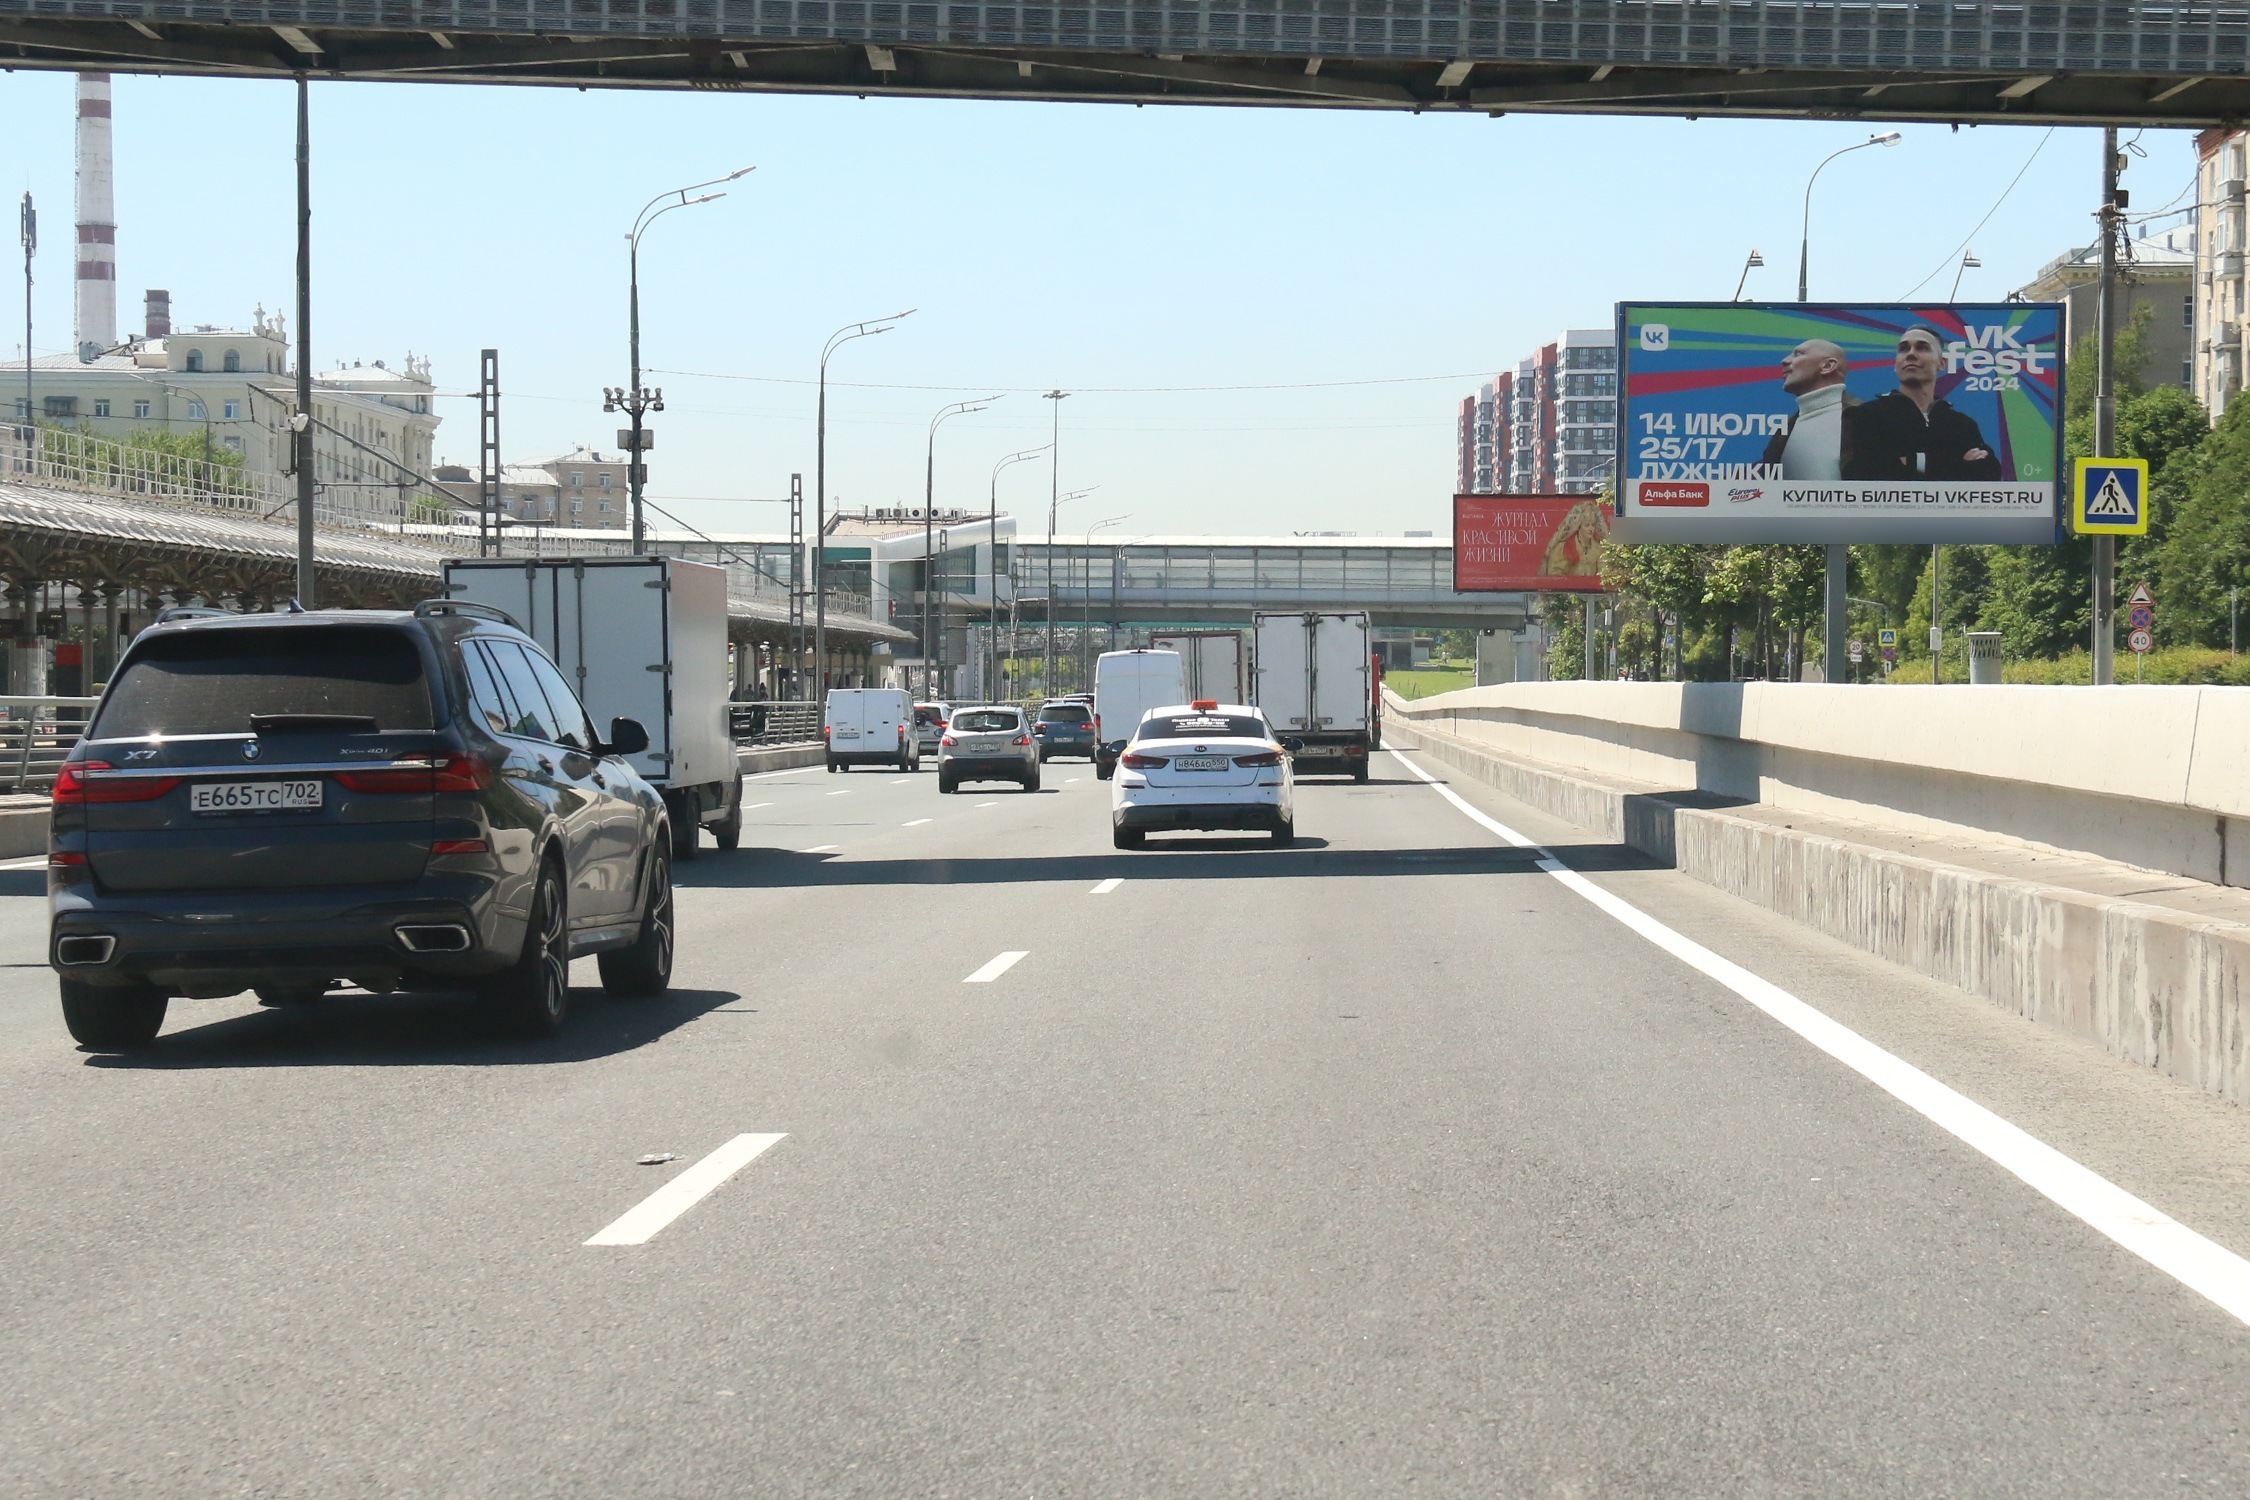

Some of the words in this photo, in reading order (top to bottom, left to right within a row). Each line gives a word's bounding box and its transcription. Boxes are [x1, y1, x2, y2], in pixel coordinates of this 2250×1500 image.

[1964, 325, 2023, 349] VK
[1942, 341, 2056, 375] fest
[1965, 376, 2020, 391] 2024
[1639, 412, 1676, 435] 14
[1685, 413, 1788, 436] ИЮЛЯ
[1639, 437, 1726, 460] 25/17
[1638, 461, 1784, 481] ЛУЖНИКИ
[2023, 463, 2042, 476] 0+
[1645, 489, 1677, 501] Альфа
[1678, 489, 1704, 499] Банк
[1783, 490, 1857, 502] КУПИТЬ
[1862, 490, 1939, 503] БИЛЕТЫ
[1945, 491, 2043, 504] VKFEST.RU
[1491, 512, 1548, 528] ЖУРНАЛ
[1463, 529, 1537, 545] КРАСИВОЙ
[1464, 547, 1510, 562] ЖИЗНИ
[2133, 636, 2147, 645] 40
[124, 750, 158, 760] X7
[285, 782, 317, 798] 702
